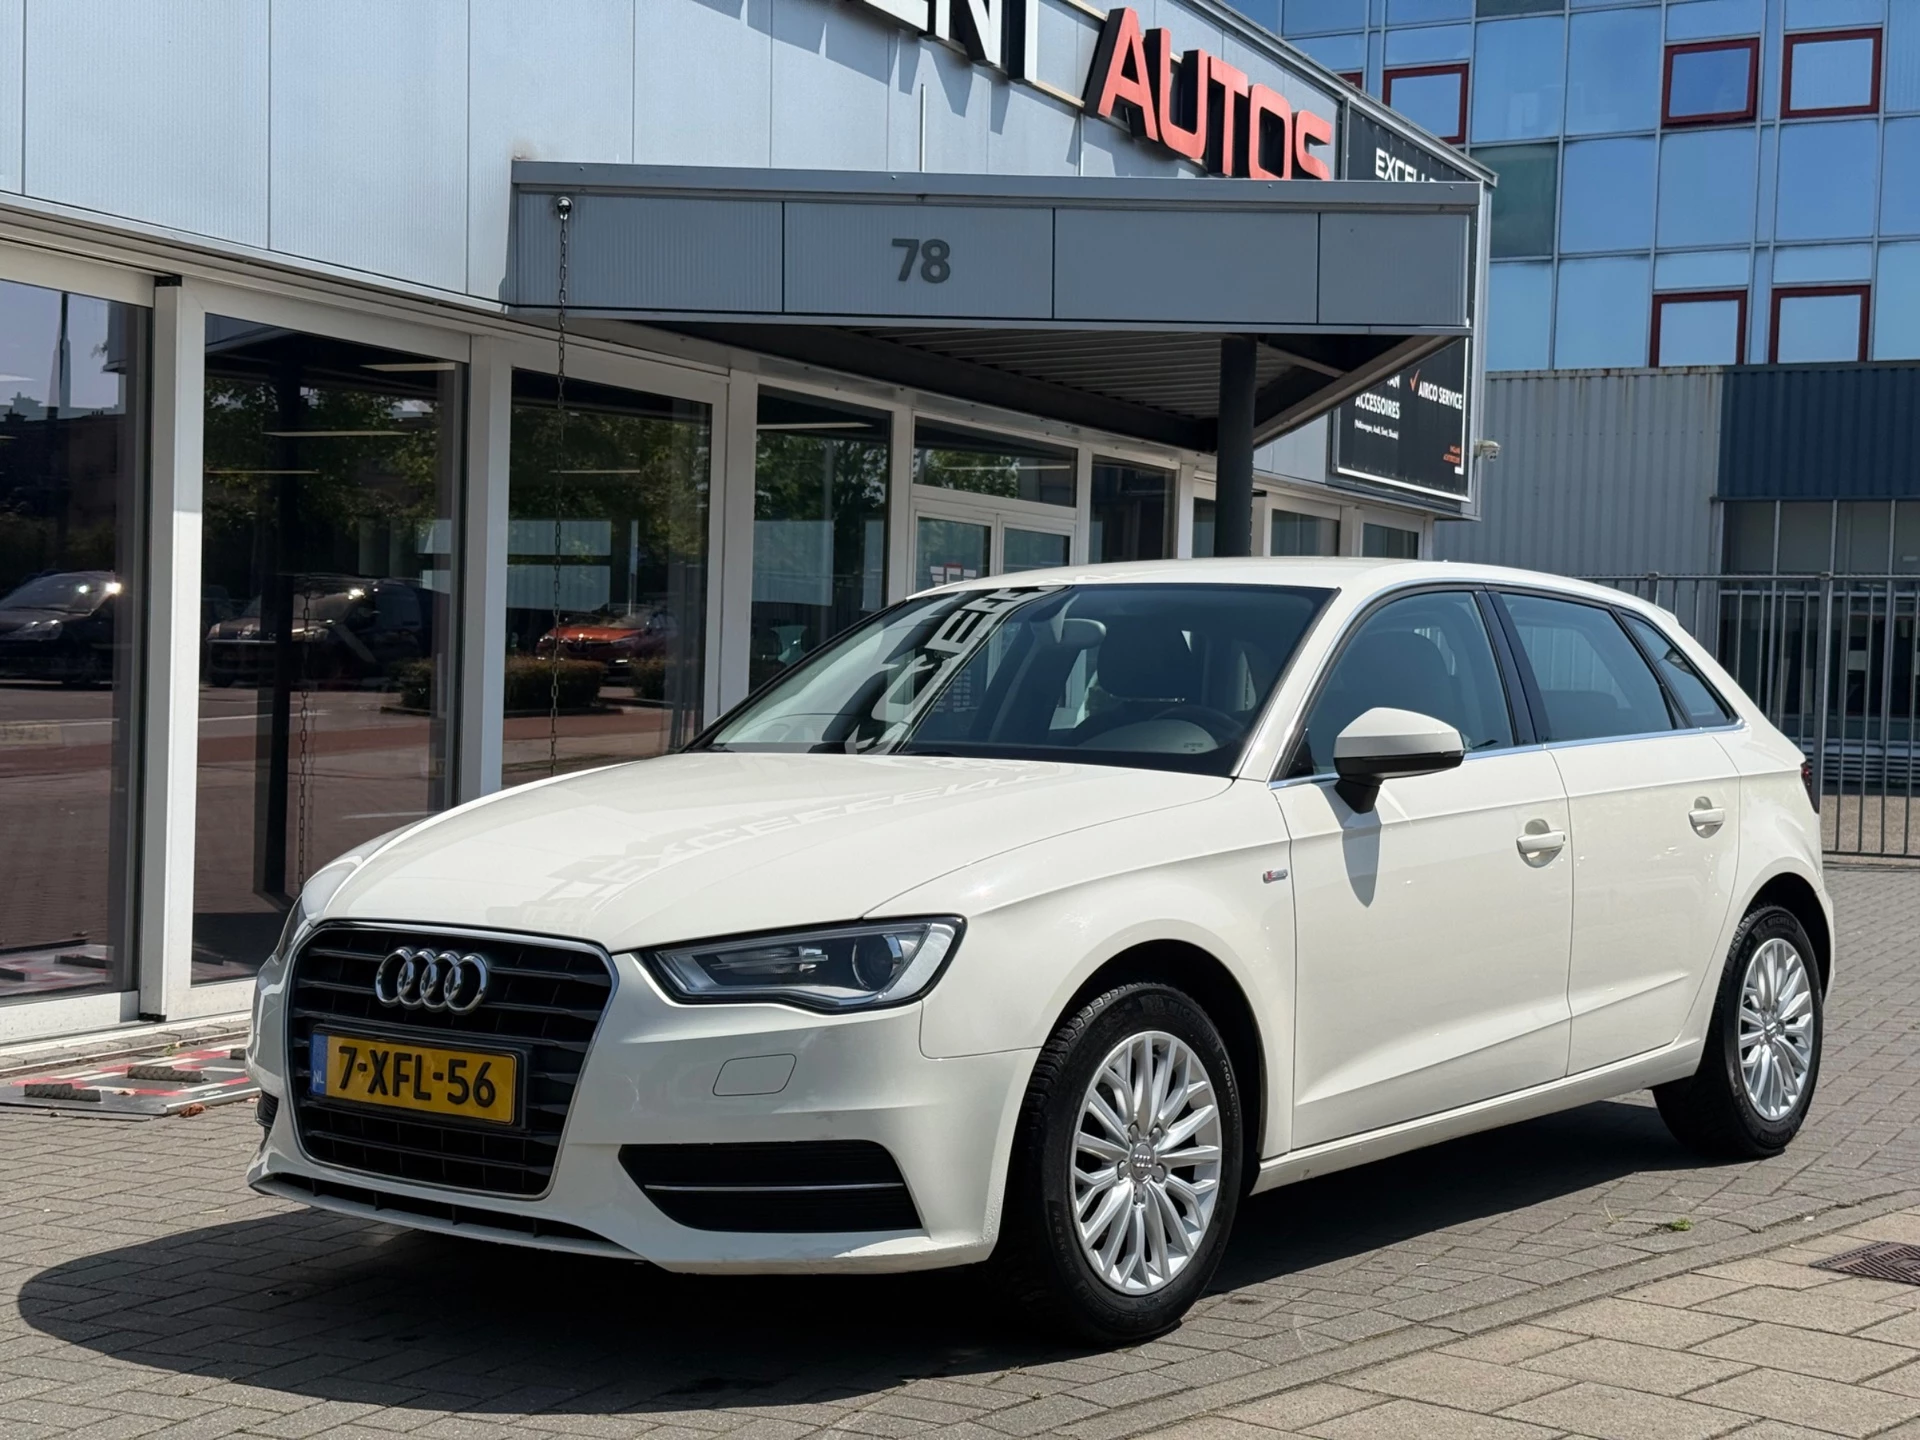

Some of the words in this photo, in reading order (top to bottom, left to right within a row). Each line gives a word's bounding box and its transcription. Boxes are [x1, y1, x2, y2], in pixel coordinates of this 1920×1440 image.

[1092, 7, 1332, 180] AUTOS
[891, 238, 951, 284] 78
[1355, 392, 1400, 420] ACCESSOIRES
[1418, 381, 1438, 402] AIRCO
[1438, 387, 1462, 410] SERVICE
[312, 1070, 325, 1085] NL
[338, 1046, 496, 1109] 7-XFL-56
